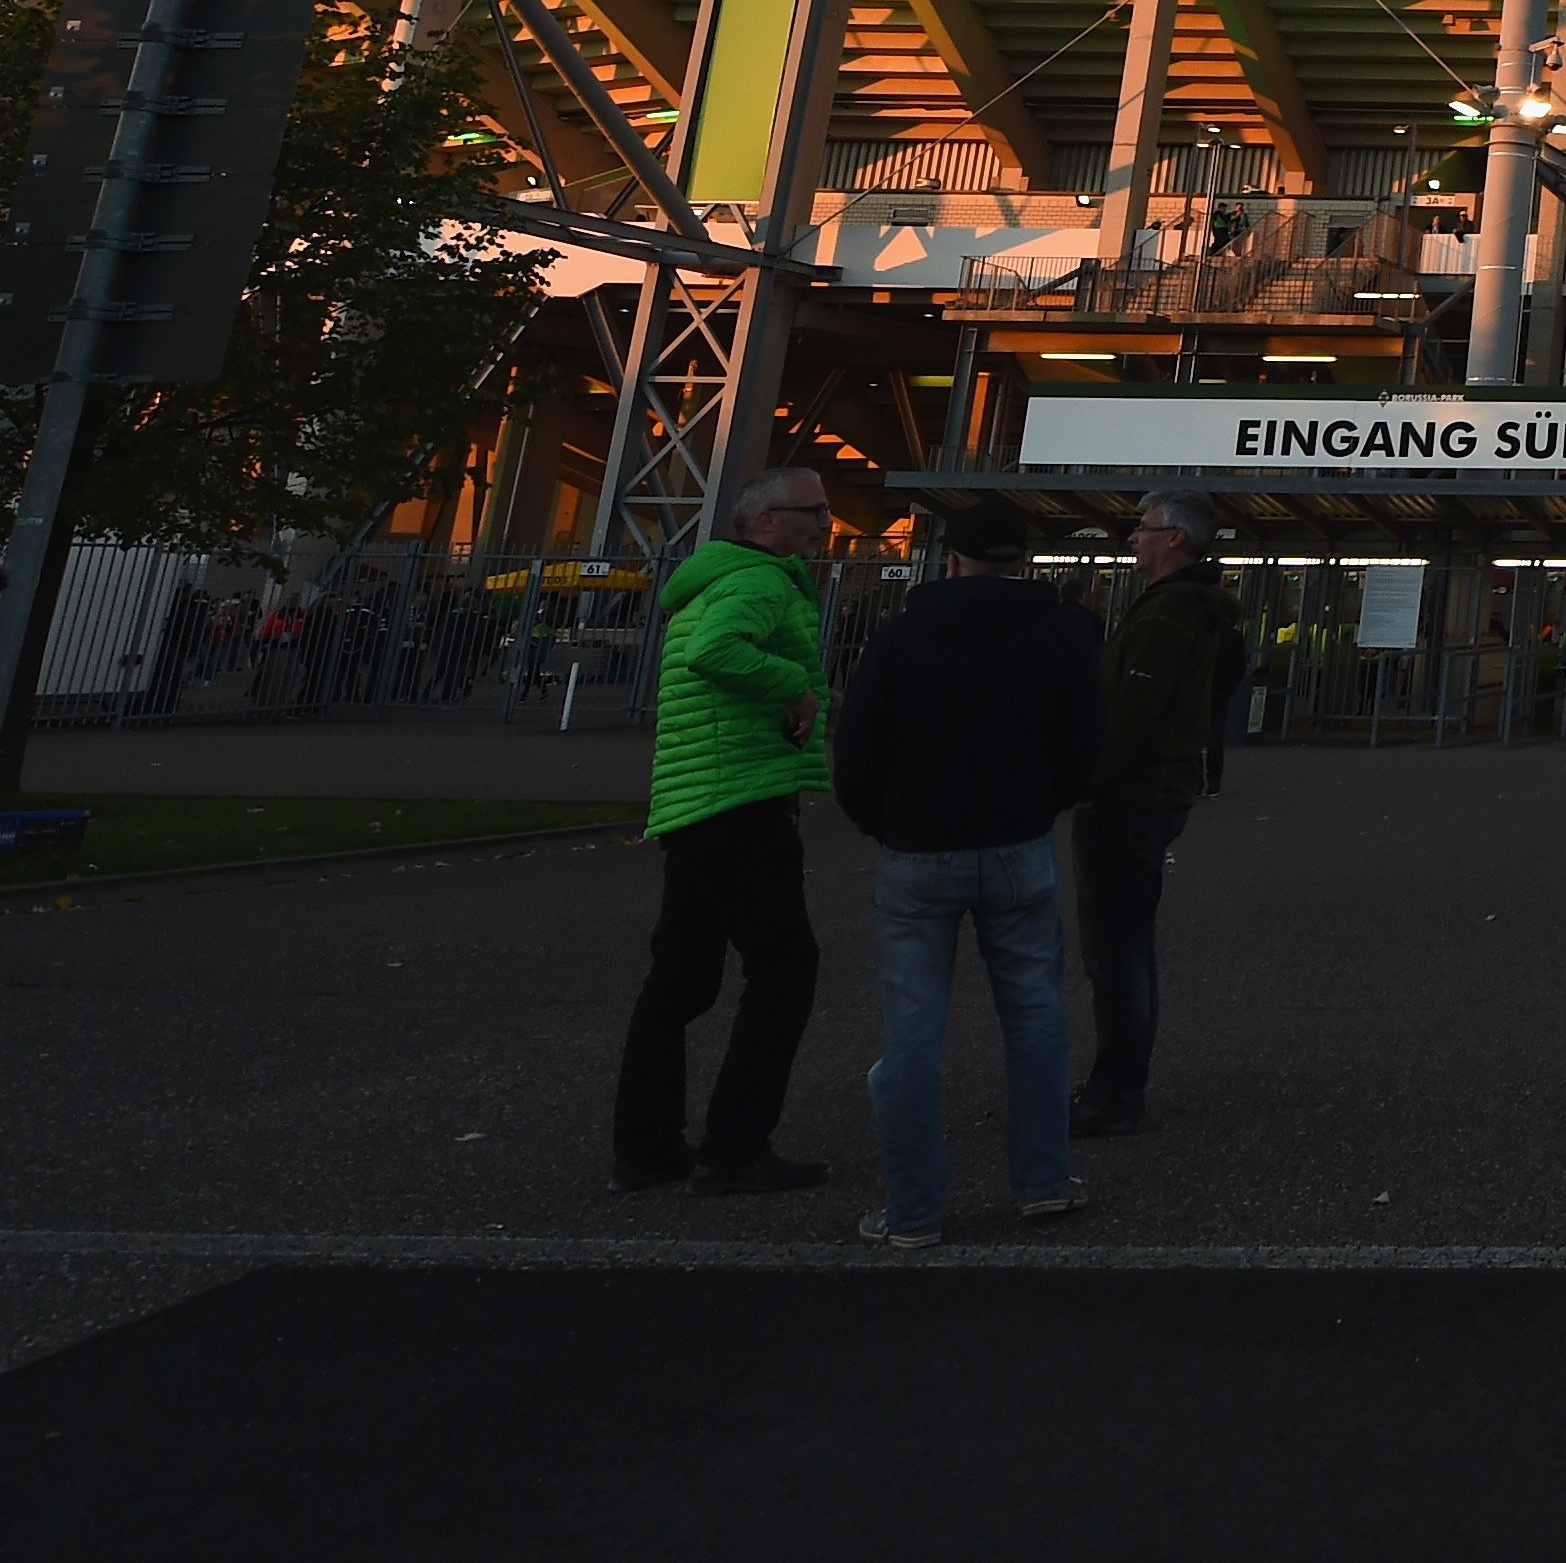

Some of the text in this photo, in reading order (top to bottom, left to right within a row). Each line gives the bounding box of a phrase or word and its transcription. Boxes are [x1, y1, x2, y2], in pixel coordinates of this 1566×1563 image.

[1391, 393, 1466, 403] BORUSSIA-PARK
[1235, 420, 1478, 458] EINGANG
[586, 564, 601, 574] 61
[888, 568, 903, 578] 60
